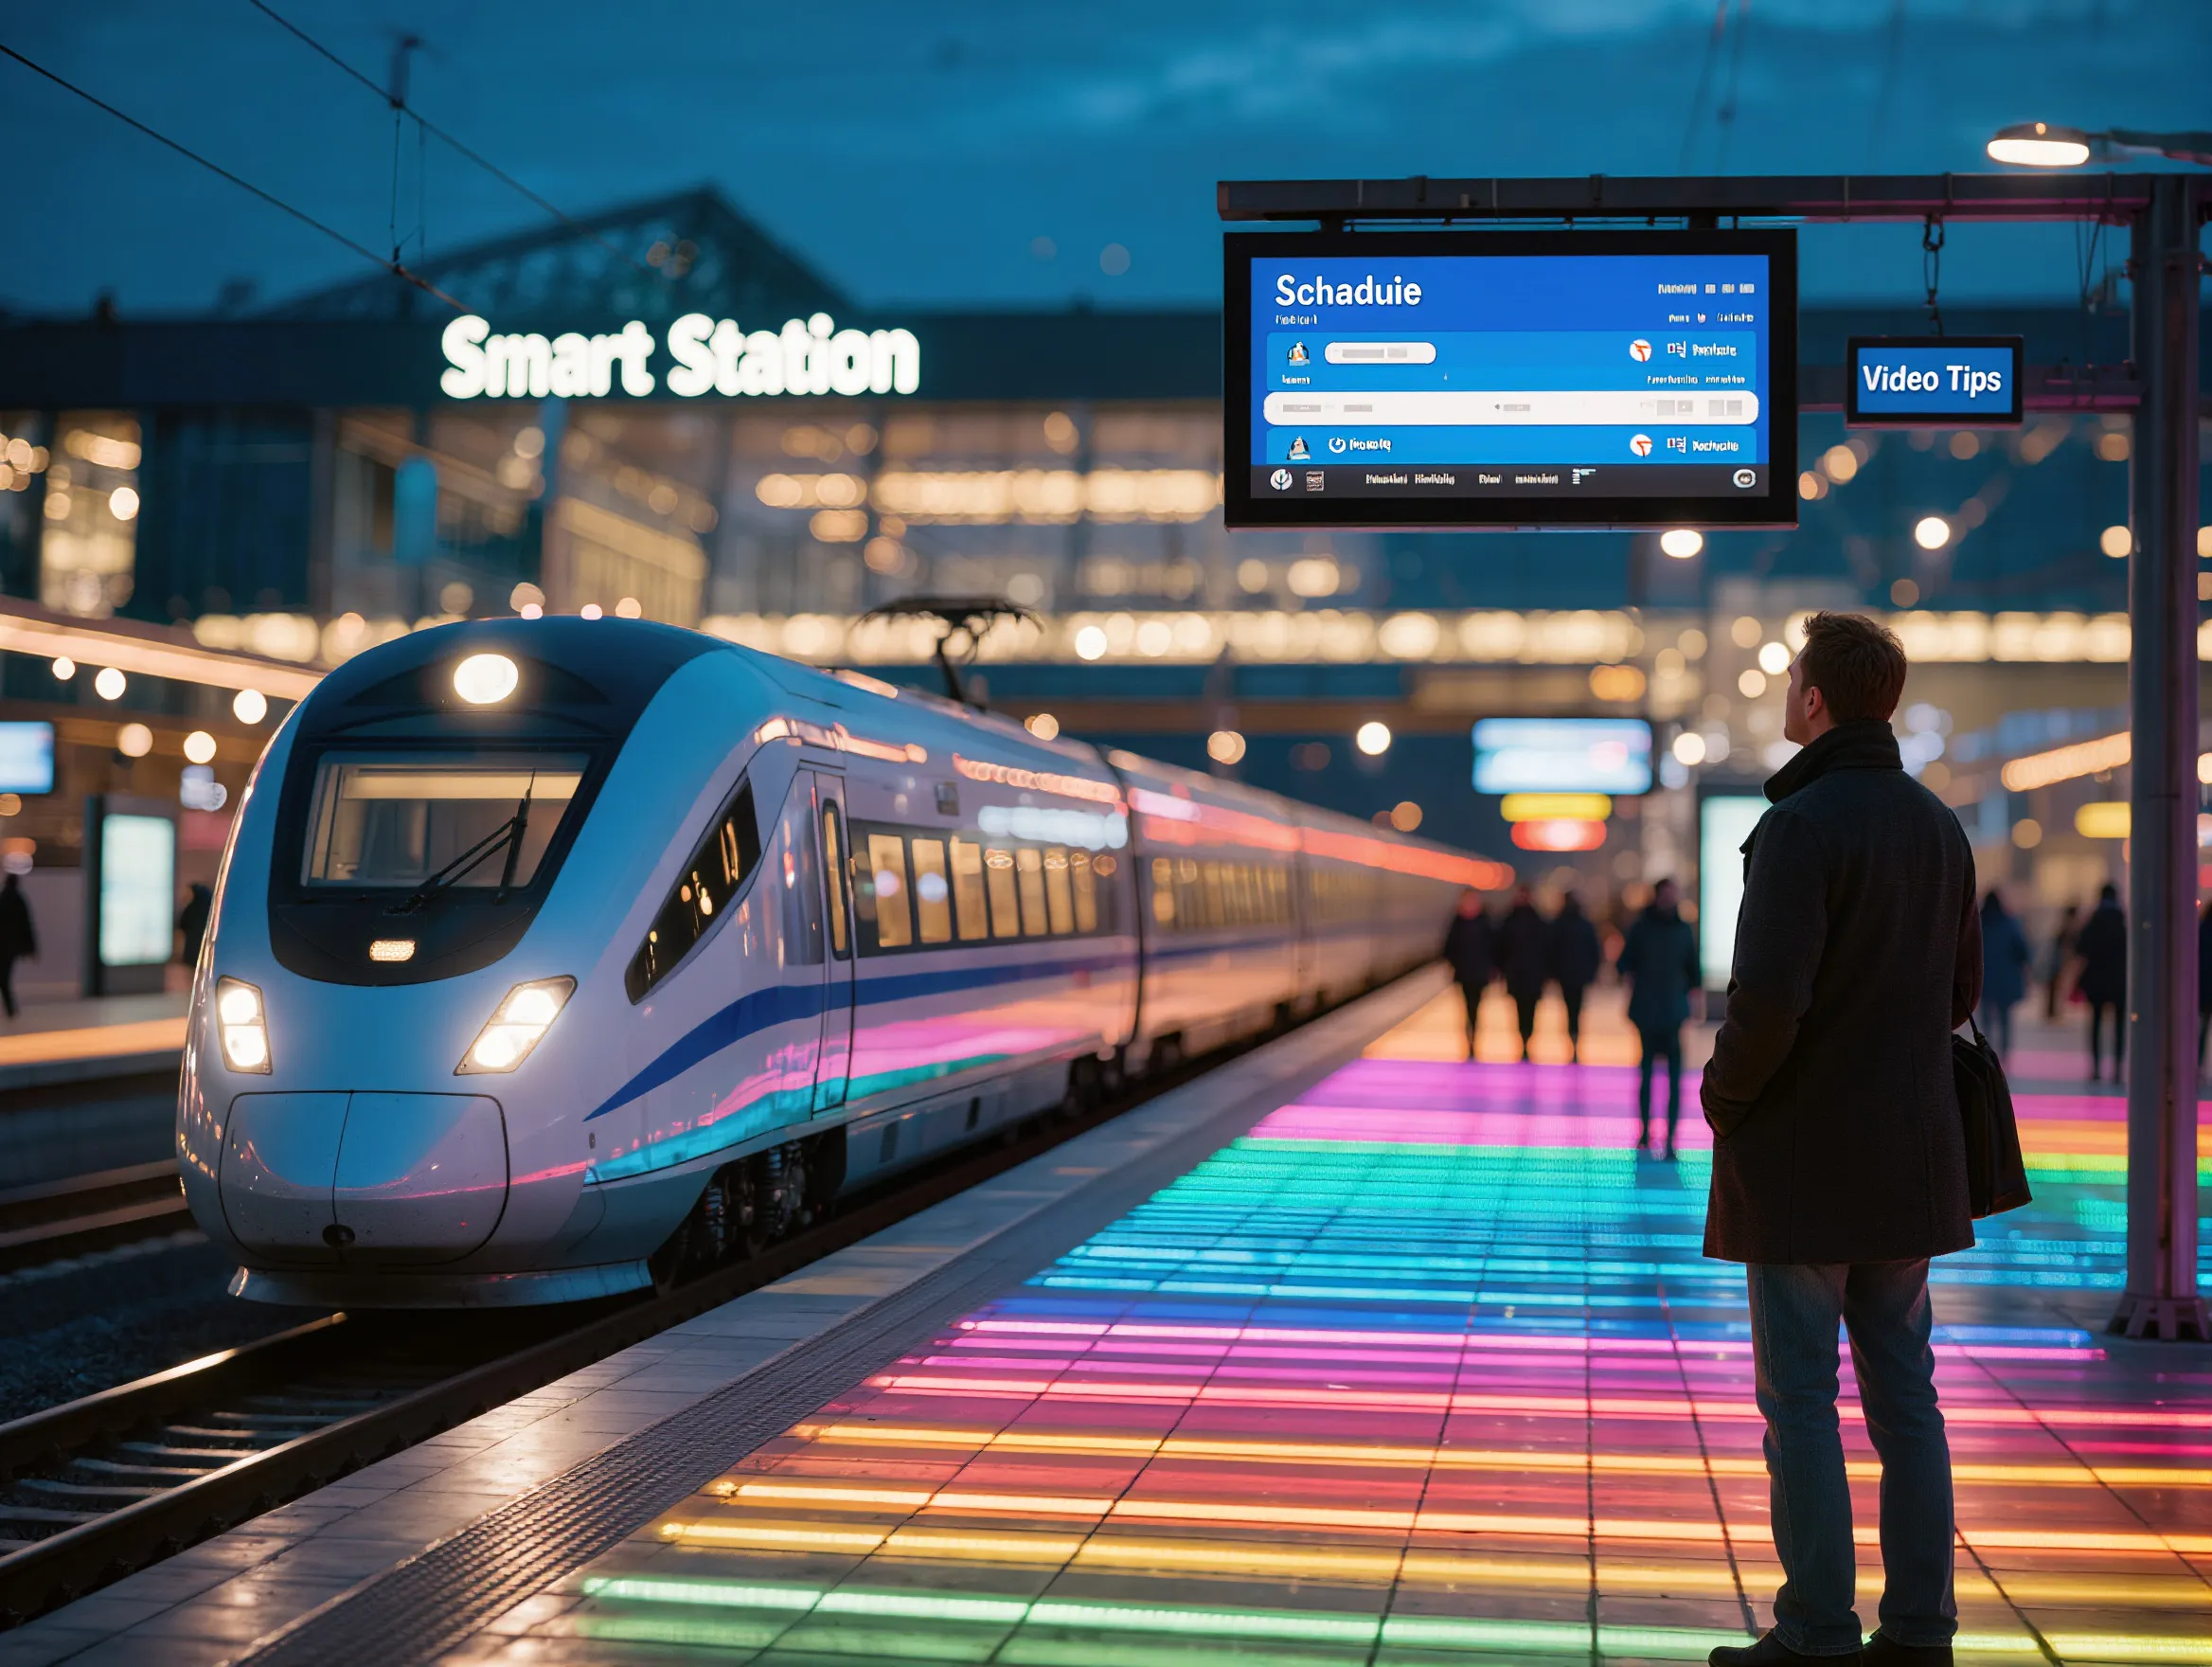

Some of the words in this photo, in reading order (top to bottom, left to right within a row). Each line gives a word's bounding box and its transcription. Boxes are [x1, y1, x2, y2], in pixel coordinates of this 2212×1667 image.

[440, 314, 655, 399] Smart
[667, 313, 920, 397] Station
[1863, 365, 1939, 392] Video
[1946, 365, 2002, 399] Tips
